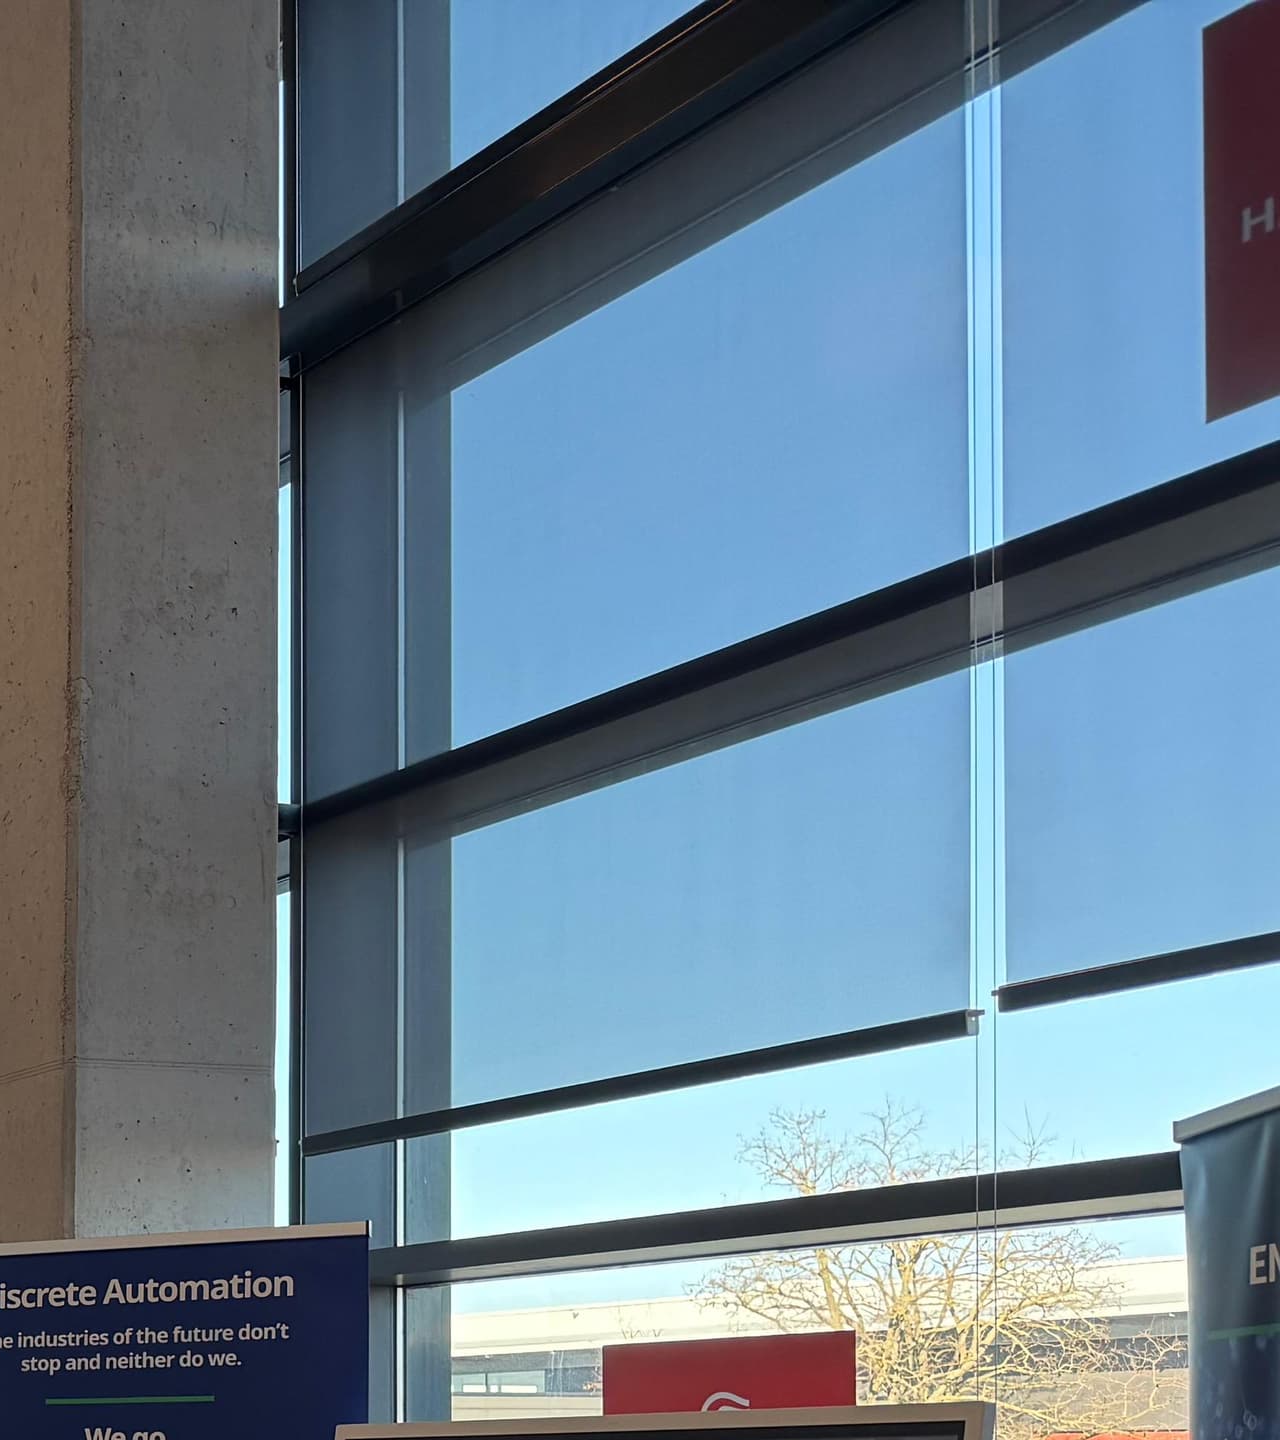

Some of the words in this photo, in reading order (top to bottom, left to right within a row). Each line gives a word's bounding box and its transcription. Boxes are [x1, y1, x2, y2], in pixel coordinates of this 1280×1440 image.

[102, 1270, 294, 1305] Automation
[17, 1329, 109, 1348] industries
[112, 1327, 134, 1345] of
[136, 1326, 169, 1344] the
[173, 1325, 234, 1344] future
[238, 1322, 290, 1341] don't
[20, 1356, 61, 1376] stop
[65, 1353, 101, 1371] and
[105, 1351, 176, 1370] neither
[179, 1350, 204, 1368] do
[208, 1352, 242, 1367] we.
